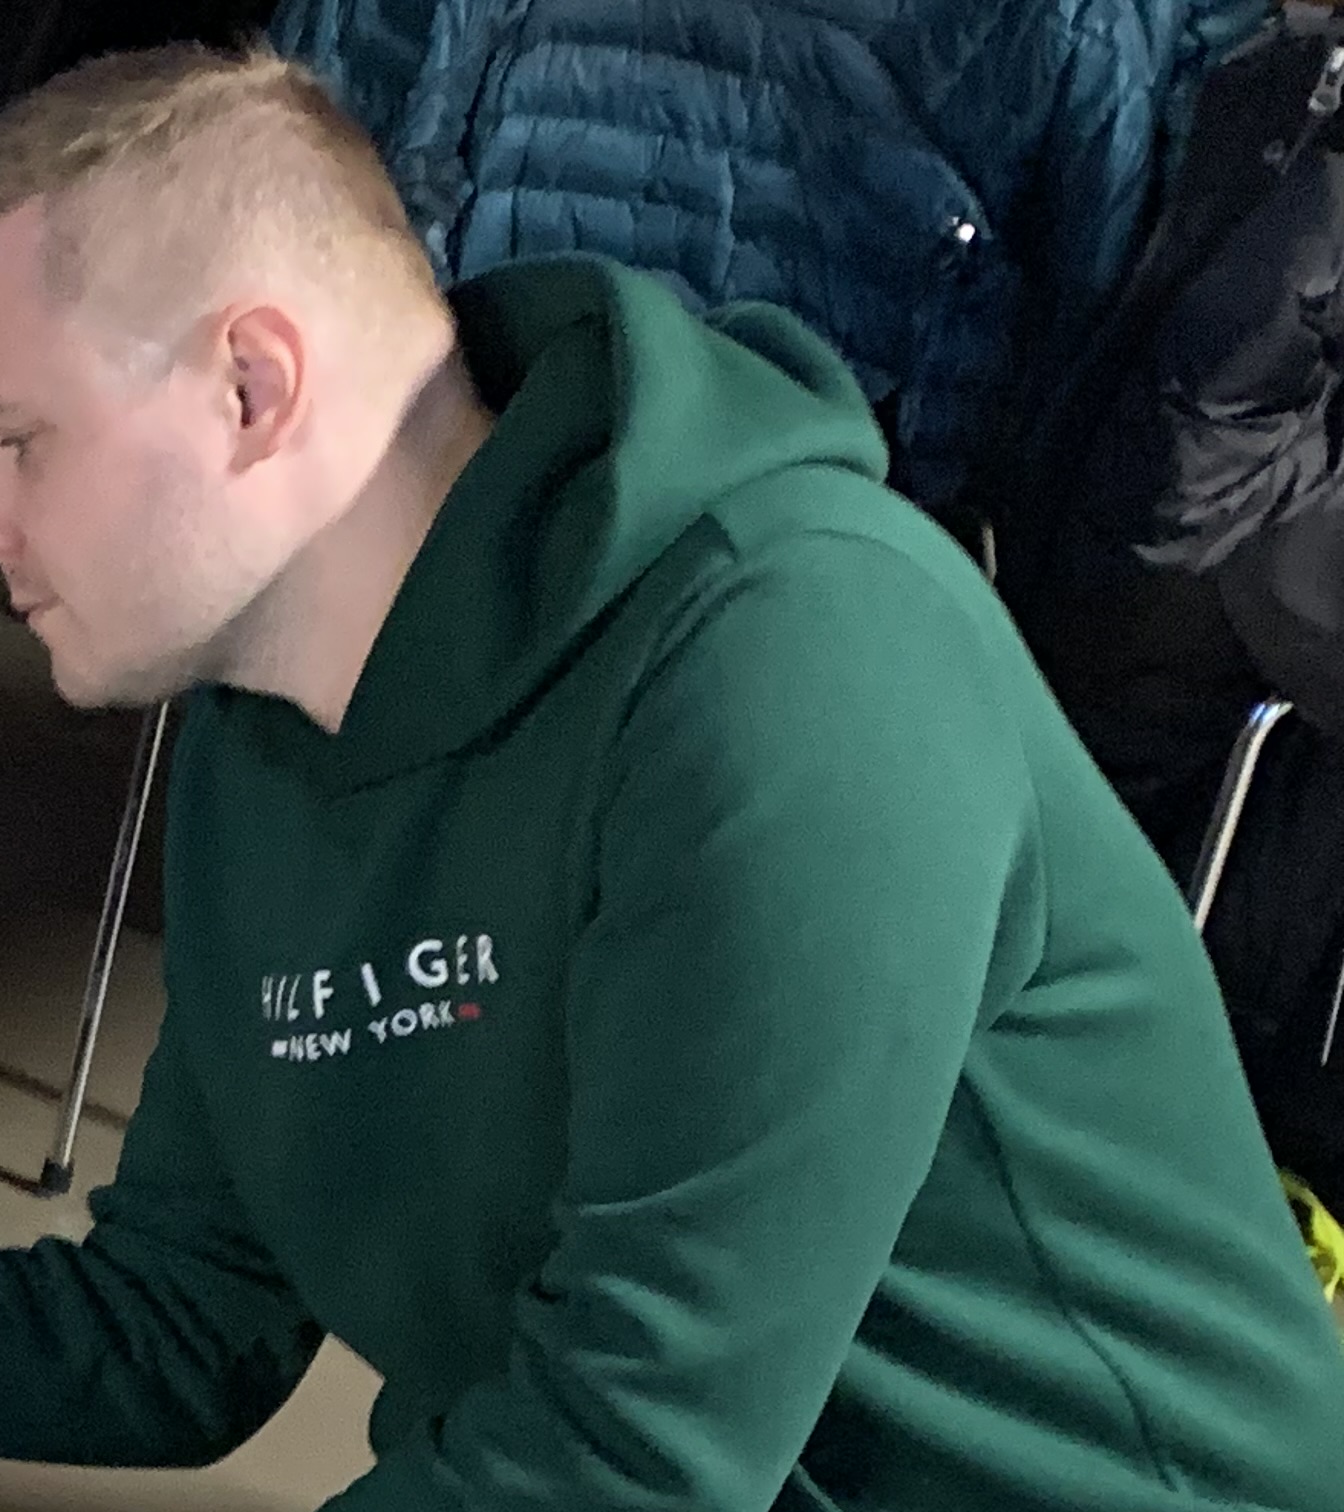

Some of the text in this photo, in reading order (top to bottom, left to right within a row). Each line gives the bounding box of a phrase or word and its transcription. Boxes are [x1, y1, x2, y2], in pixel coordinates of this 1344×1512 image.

[262, 934, 499, 1022] HILFIGER
[288, 1000, 455, 1061] NEW YORK
